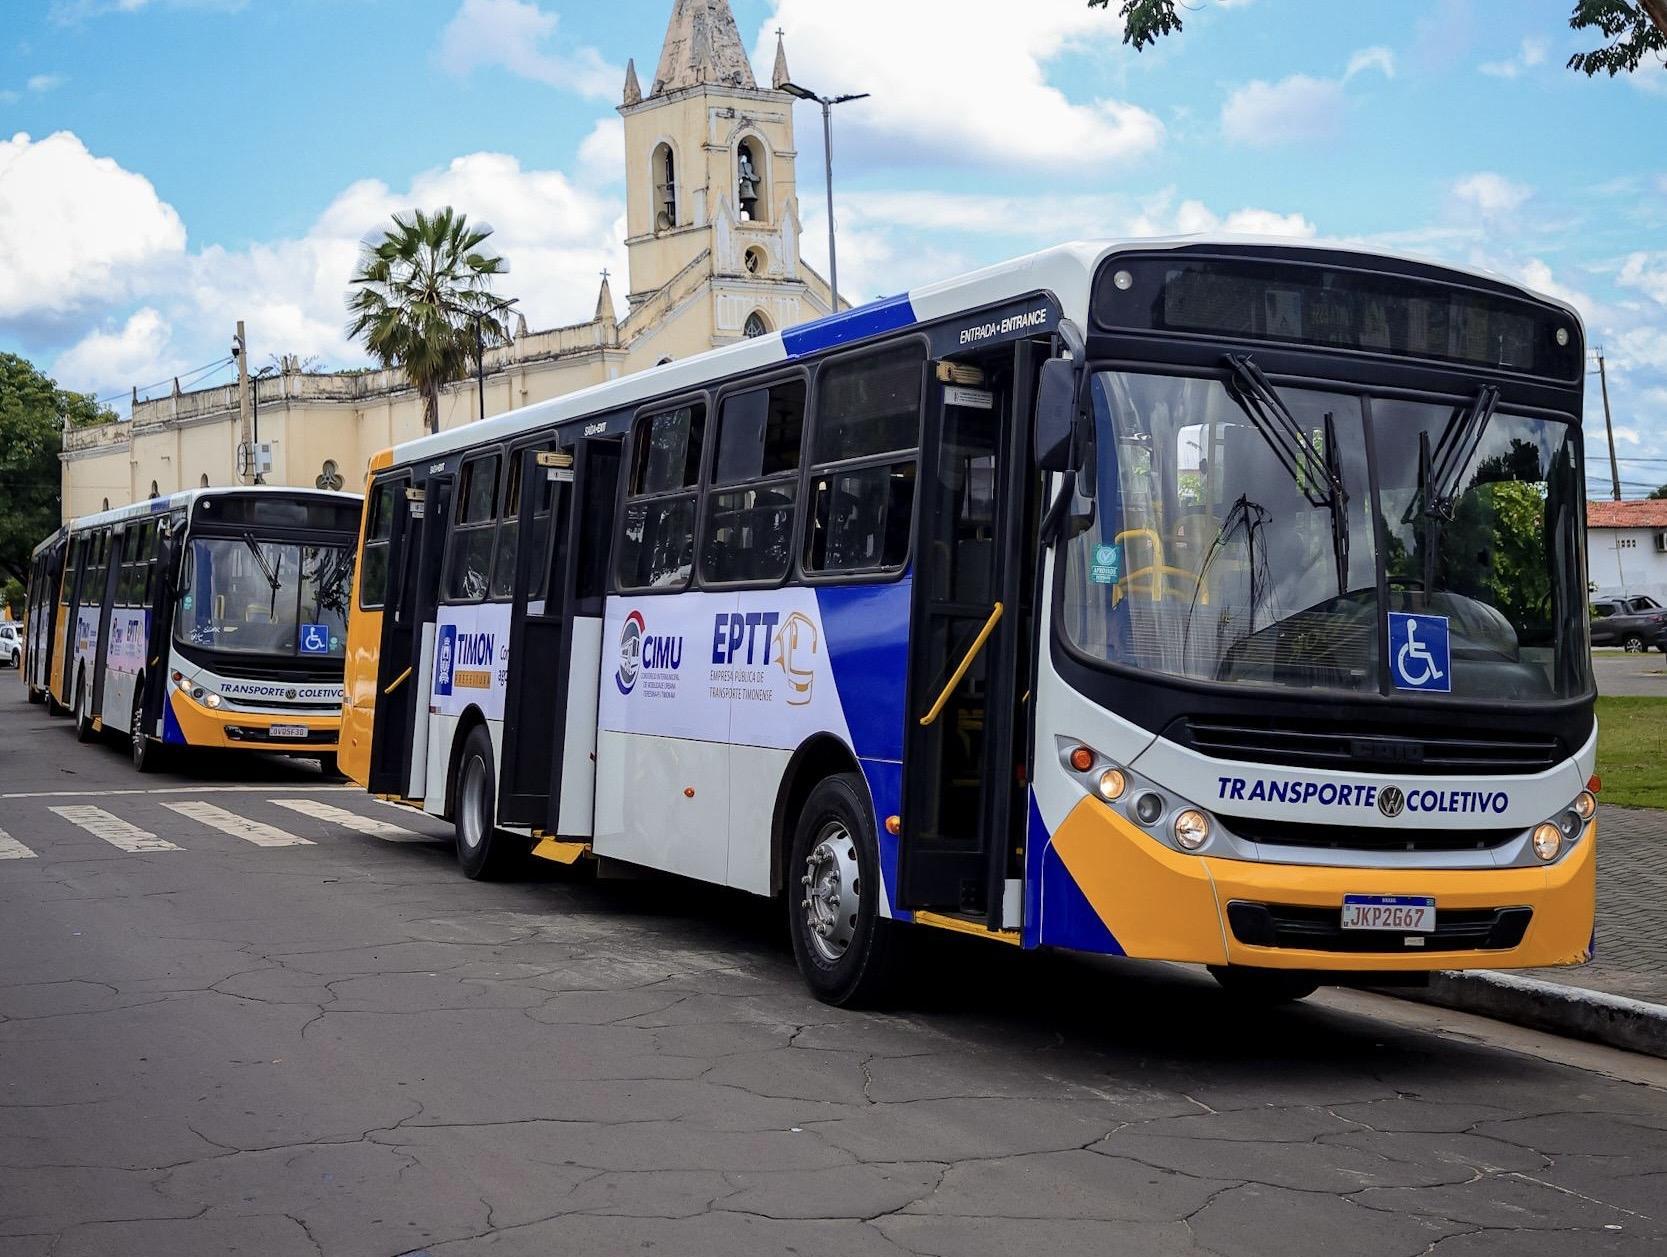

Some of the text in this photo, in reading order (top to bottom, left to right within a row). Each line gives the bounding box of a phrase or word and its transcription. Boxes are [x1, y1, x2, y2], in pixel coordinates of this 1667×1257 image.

[960, 308, 1047, 344] ENTRADA ENTRANCE
[458, 633, 495, 665] TIMON
[642, 635, 683, 669] CIMU
[712, 612, 779, 665] EPTT
[220, 684, 286, 697] TRANSPORTE
[710, 669, 764, 683] EMPRESA PÚBLICA DE
[709, 687, 773, 701] TRANSPORTE TIMONENSE
[1218, 777, 1377, 807] TRANSPORTE
[1405, 790, 1509, 814] COLETIVO
[1351, 907, 1425, 928] JKP2G67
